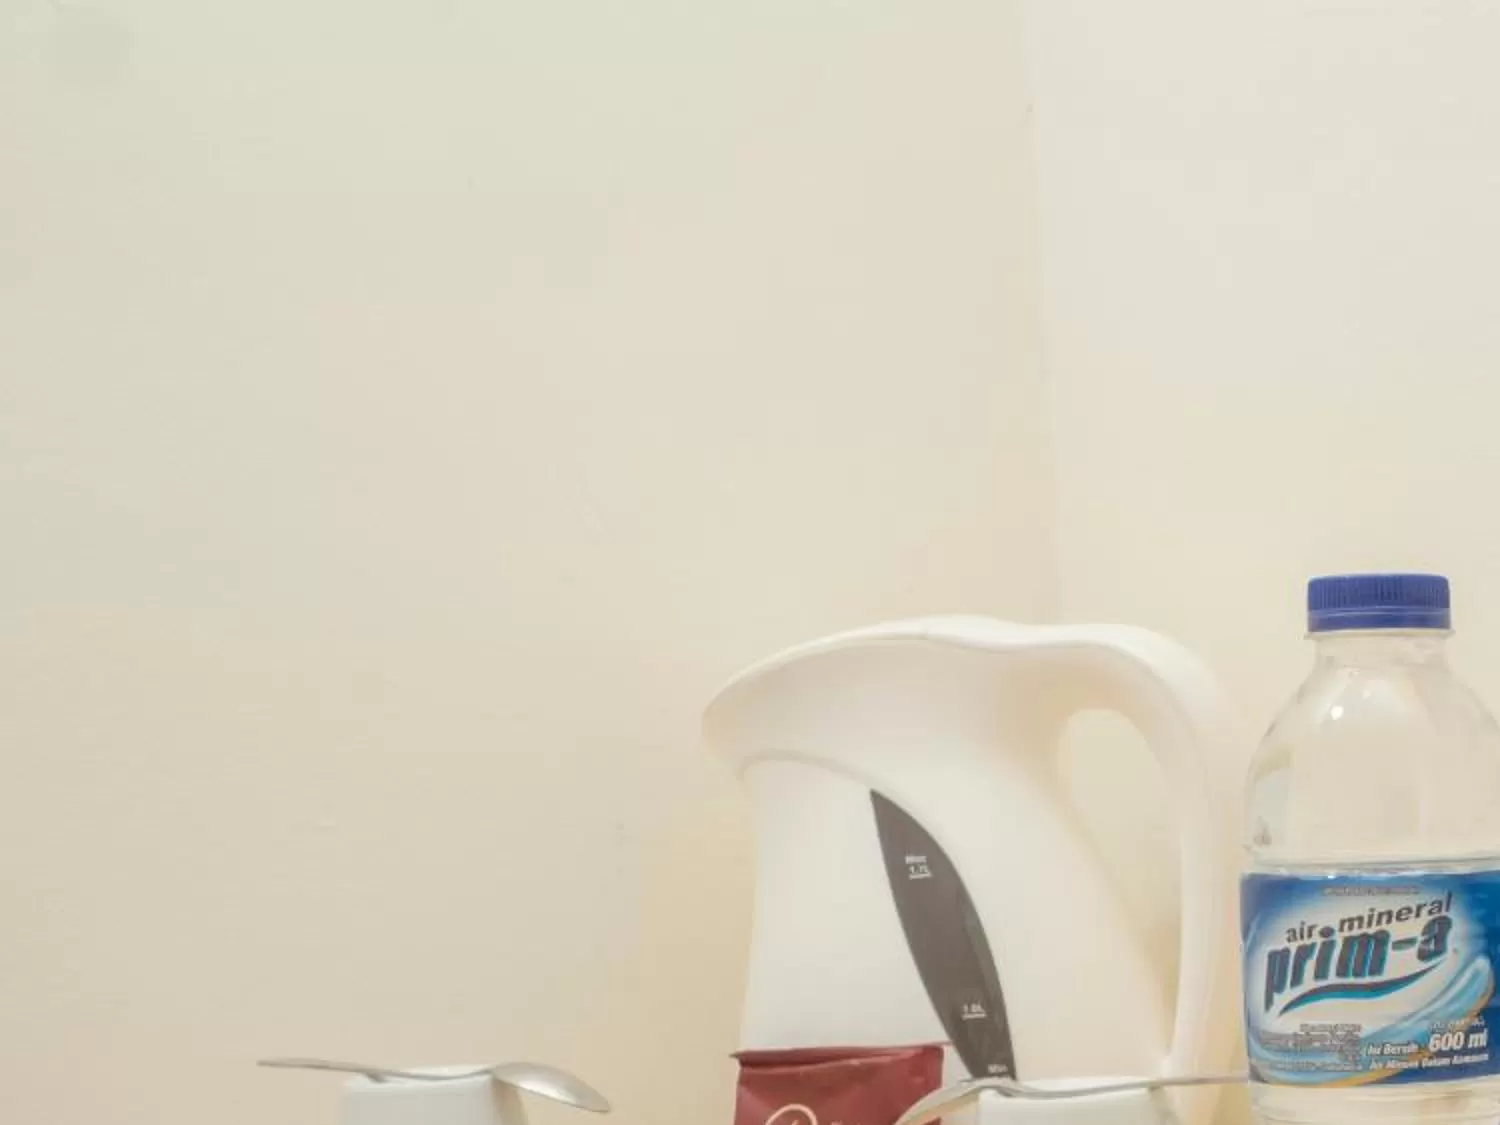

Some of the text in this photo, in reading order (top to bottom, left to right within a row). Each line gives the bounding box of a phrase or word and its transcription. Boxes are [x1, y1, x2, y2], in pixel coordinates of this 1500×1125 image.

[1285, 891, 1452, 944] air mineral
[1264, 915, 1453, 1014] prim-a
[1428, 1030, 1465, 1053] 600
[1468, 1027, 1488, 1049] ml
